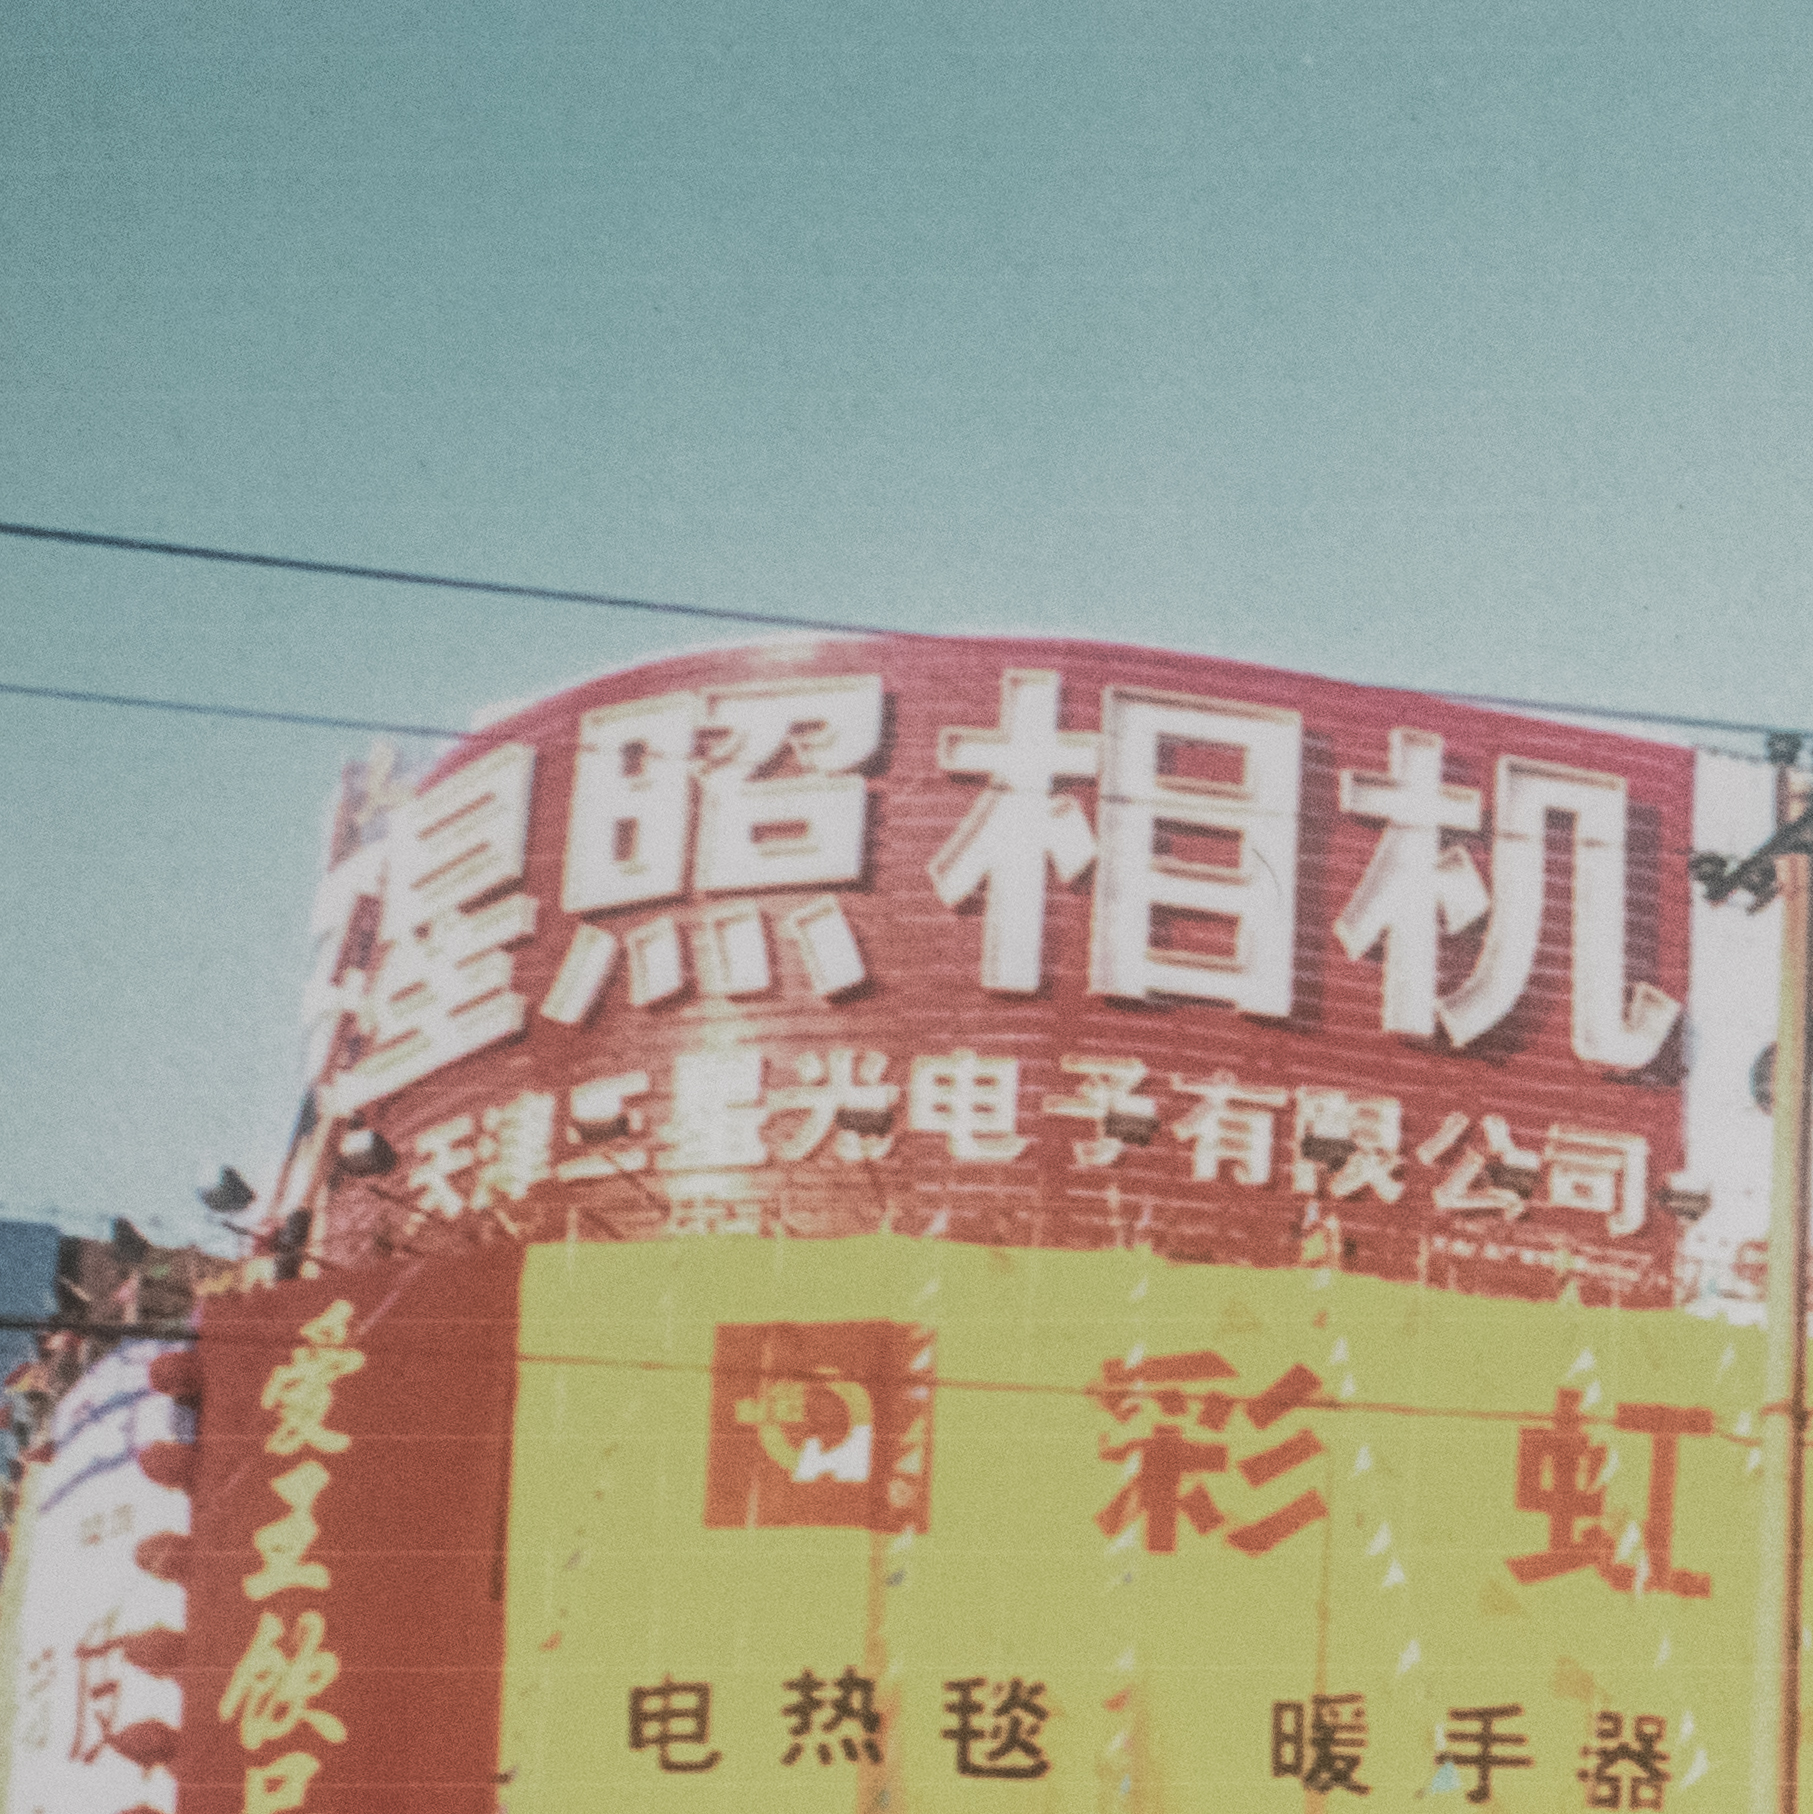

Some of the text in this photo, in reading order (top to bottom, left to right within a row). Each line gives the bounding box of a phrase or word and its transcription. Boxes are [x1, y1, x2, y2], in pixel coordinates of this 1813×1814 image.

[406, 1044, 1650, 1235] 天津三星光电子有限公司
[1090, 1351, 1713, 1599] 彩虹
[628, 1670, 1672, 1810] 电热毯 暖手器
